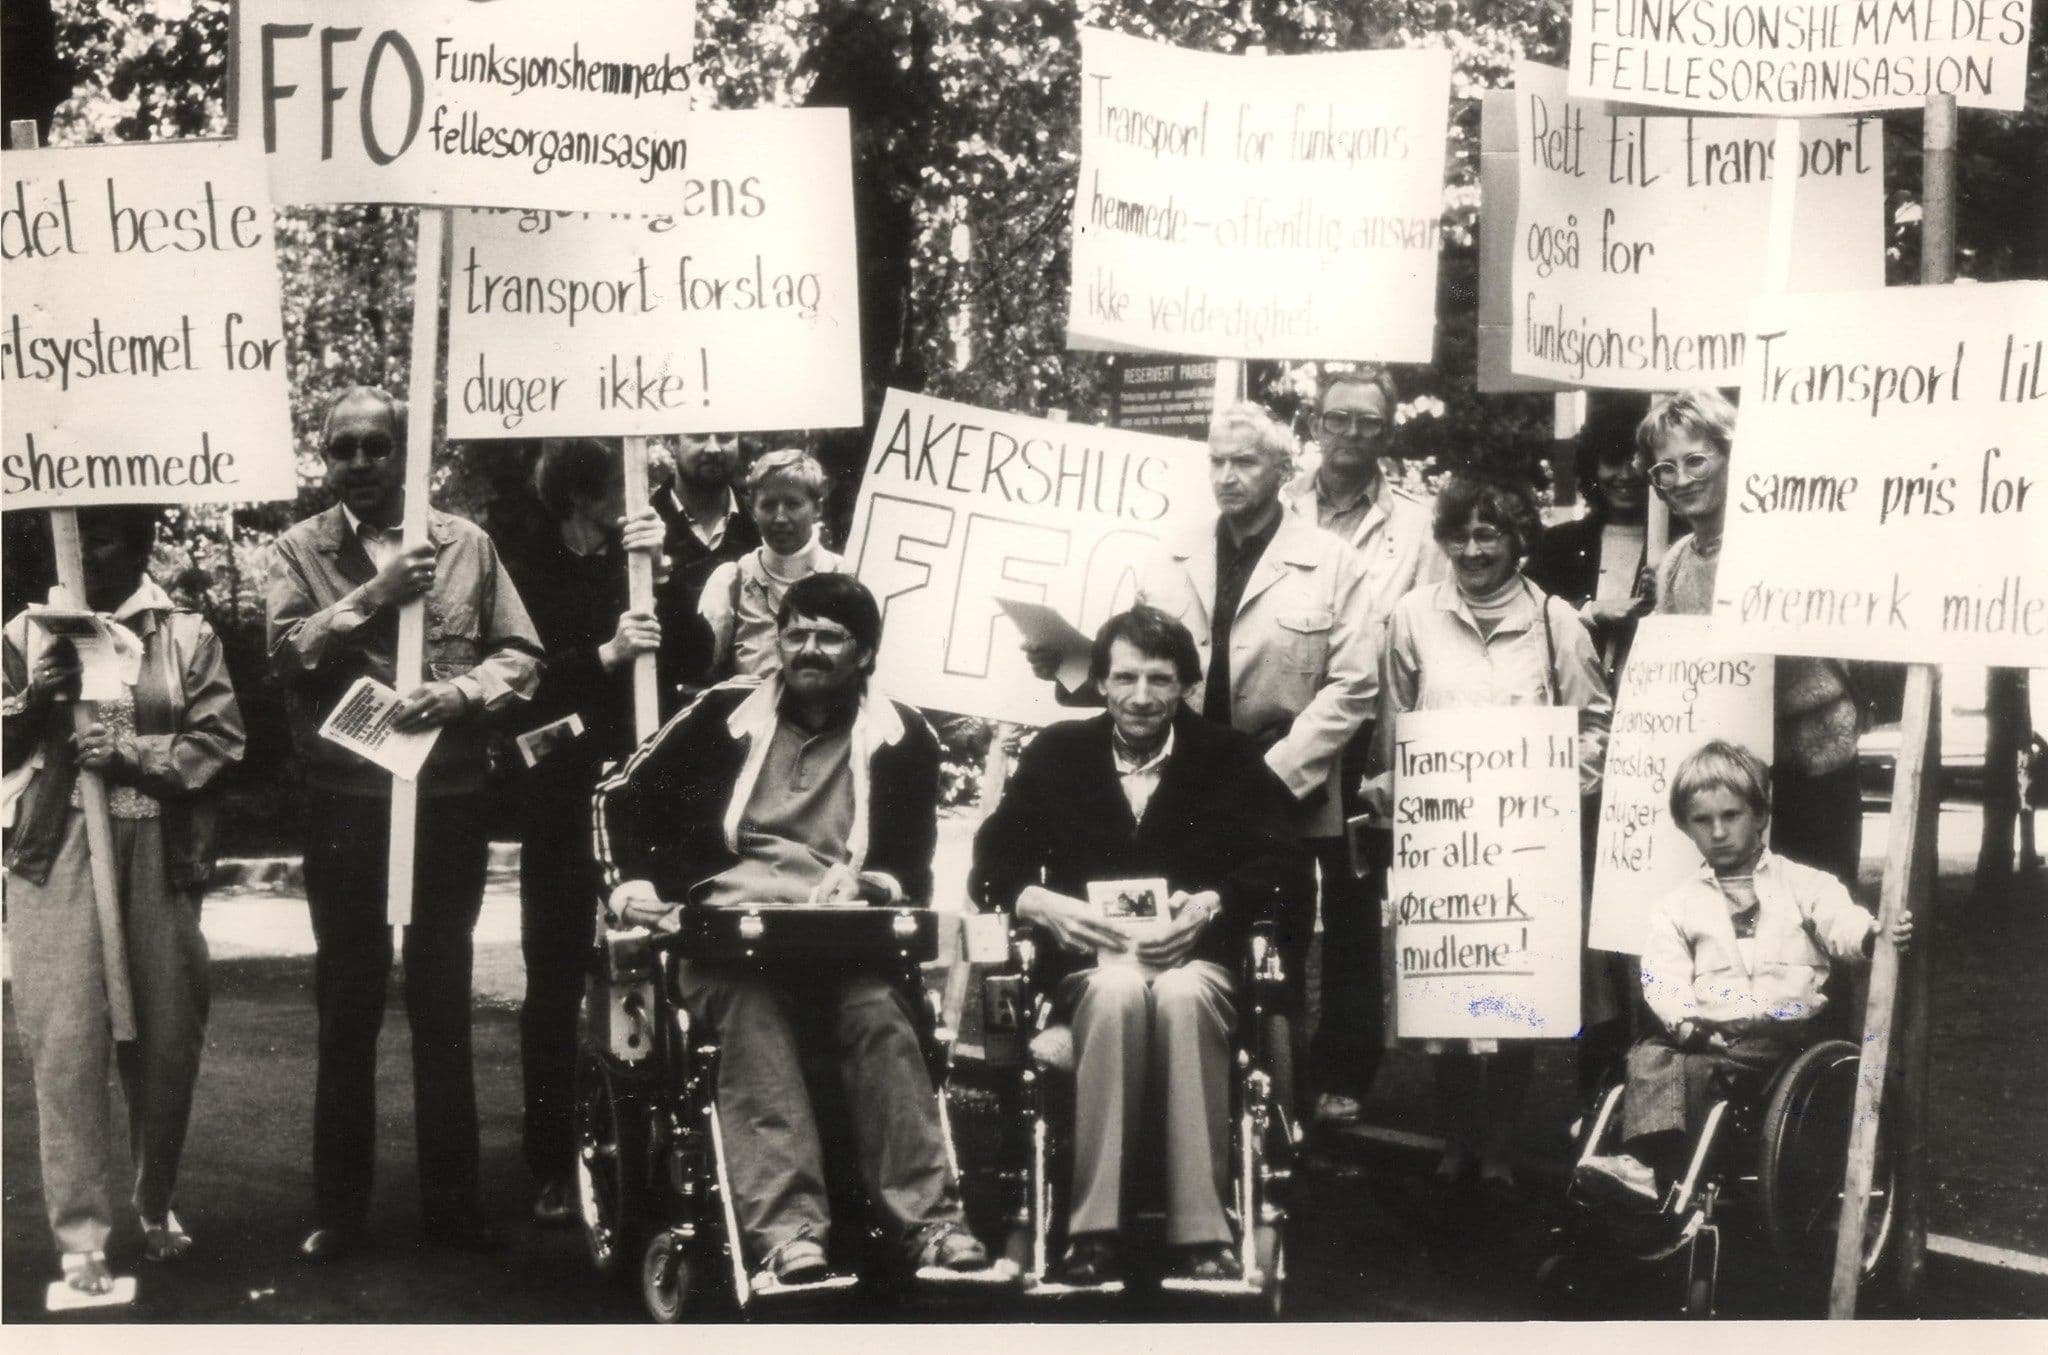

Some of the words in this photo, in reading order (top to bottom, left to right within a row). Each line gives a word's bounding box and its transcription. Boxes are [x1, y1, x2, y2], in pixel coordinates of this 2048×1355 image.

[1592, 0, 2025, 51] FUNKSJONSHEMMEDES
[261, 22, 424, 166] FFO
[435, 36, 690, 98] Funksjonshemmedes
[1590, 42, 1993, 102] FELLESORGANISASJON
[429, 103, 688, 183] fellesorganisasjon
[1089, 72, 1208, 160] Transport
[1236, 103, 1275, 163] for
[1530, 93, 1585, 177] Rett
[1599, 115, 1659, 187] til
[0, 179, 84, 260] det
[106, 177, 262, 254] beste
[1090, 168, 1187, 242] hemmede
[1527, 214, 1580, 278] også
[1602, 208, 1655, 274] for
[463, 247, 657, 328] transport
[678, 254, 822, 320] forslag
[1088, 270, 1130, 322] ikke
[221, 312, 281, 371] for
[1755, 330, 1965, 417] Transport
[2000, 333, 2047, 403] til
[463, 352, 567, 429] duger
[2, 431, 240, 494] shemmede
[873, 408, 1170, 521] AKERSHUS
[1740, 472, 1858, 514] samme
[1879, 462, 1957, 525] pris
[1979, 447, 2036, 515] for
[1740, 572, 1911, 631] øremerk
[1942, 576, 2046, 637] midle
[1396, 735, 1528, 783] Transport
[1549, 735, 1574, 769] til
[1397, 795, 1474, 825] samme
[1498, 795, 1559, 828] pris
[1397, 832, 1436, 868] for
[1443, 830, 1503, 868] alle
